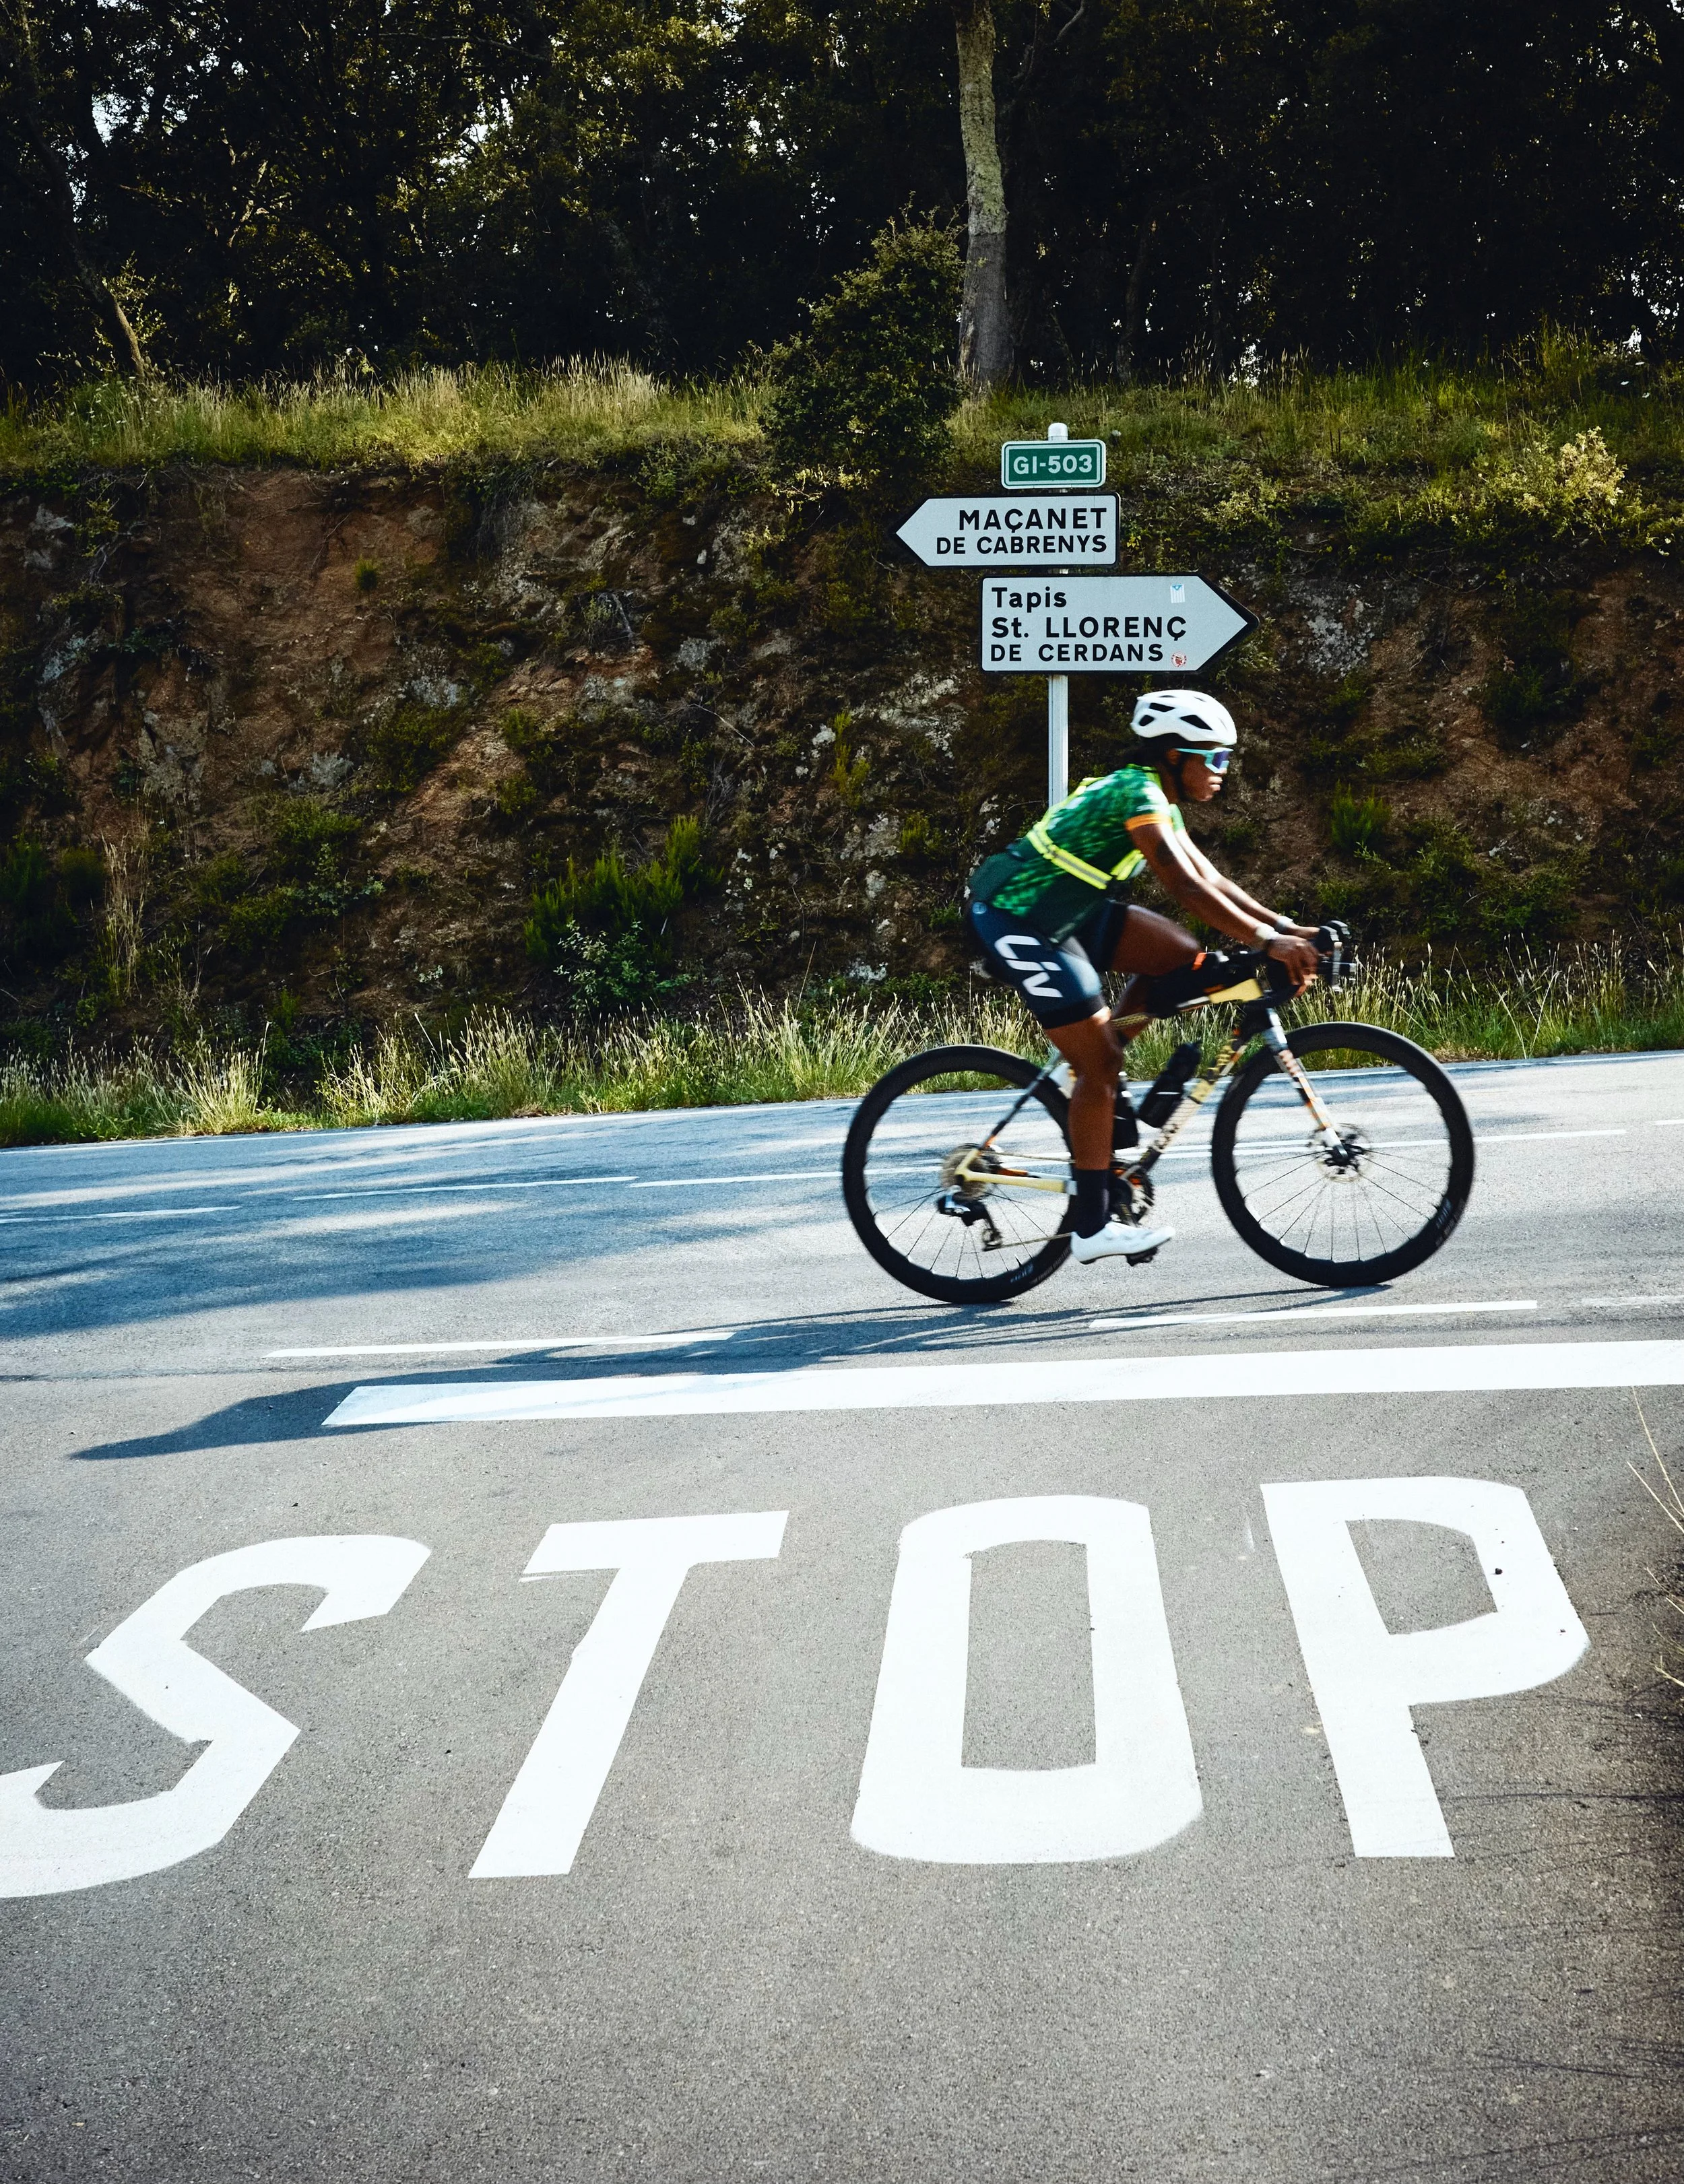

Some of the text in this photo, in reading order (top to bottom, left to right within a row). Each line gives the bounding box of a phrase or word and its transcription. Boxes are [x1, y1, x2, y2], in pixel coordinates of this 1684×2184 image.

[1013, 455, 1093, 475] GI-503
[959, 508, 1107, 533] MAÇANET
[936, 535, 1107, 555] DE CABRENYS
[991, 587, 1067, 614] Tapis
[991, 616, 1187, 641] St. LLORENÇ
[990, 643, 1163, 663] DE CERDANS
[0, 1476, 1590, 1898] STOP
